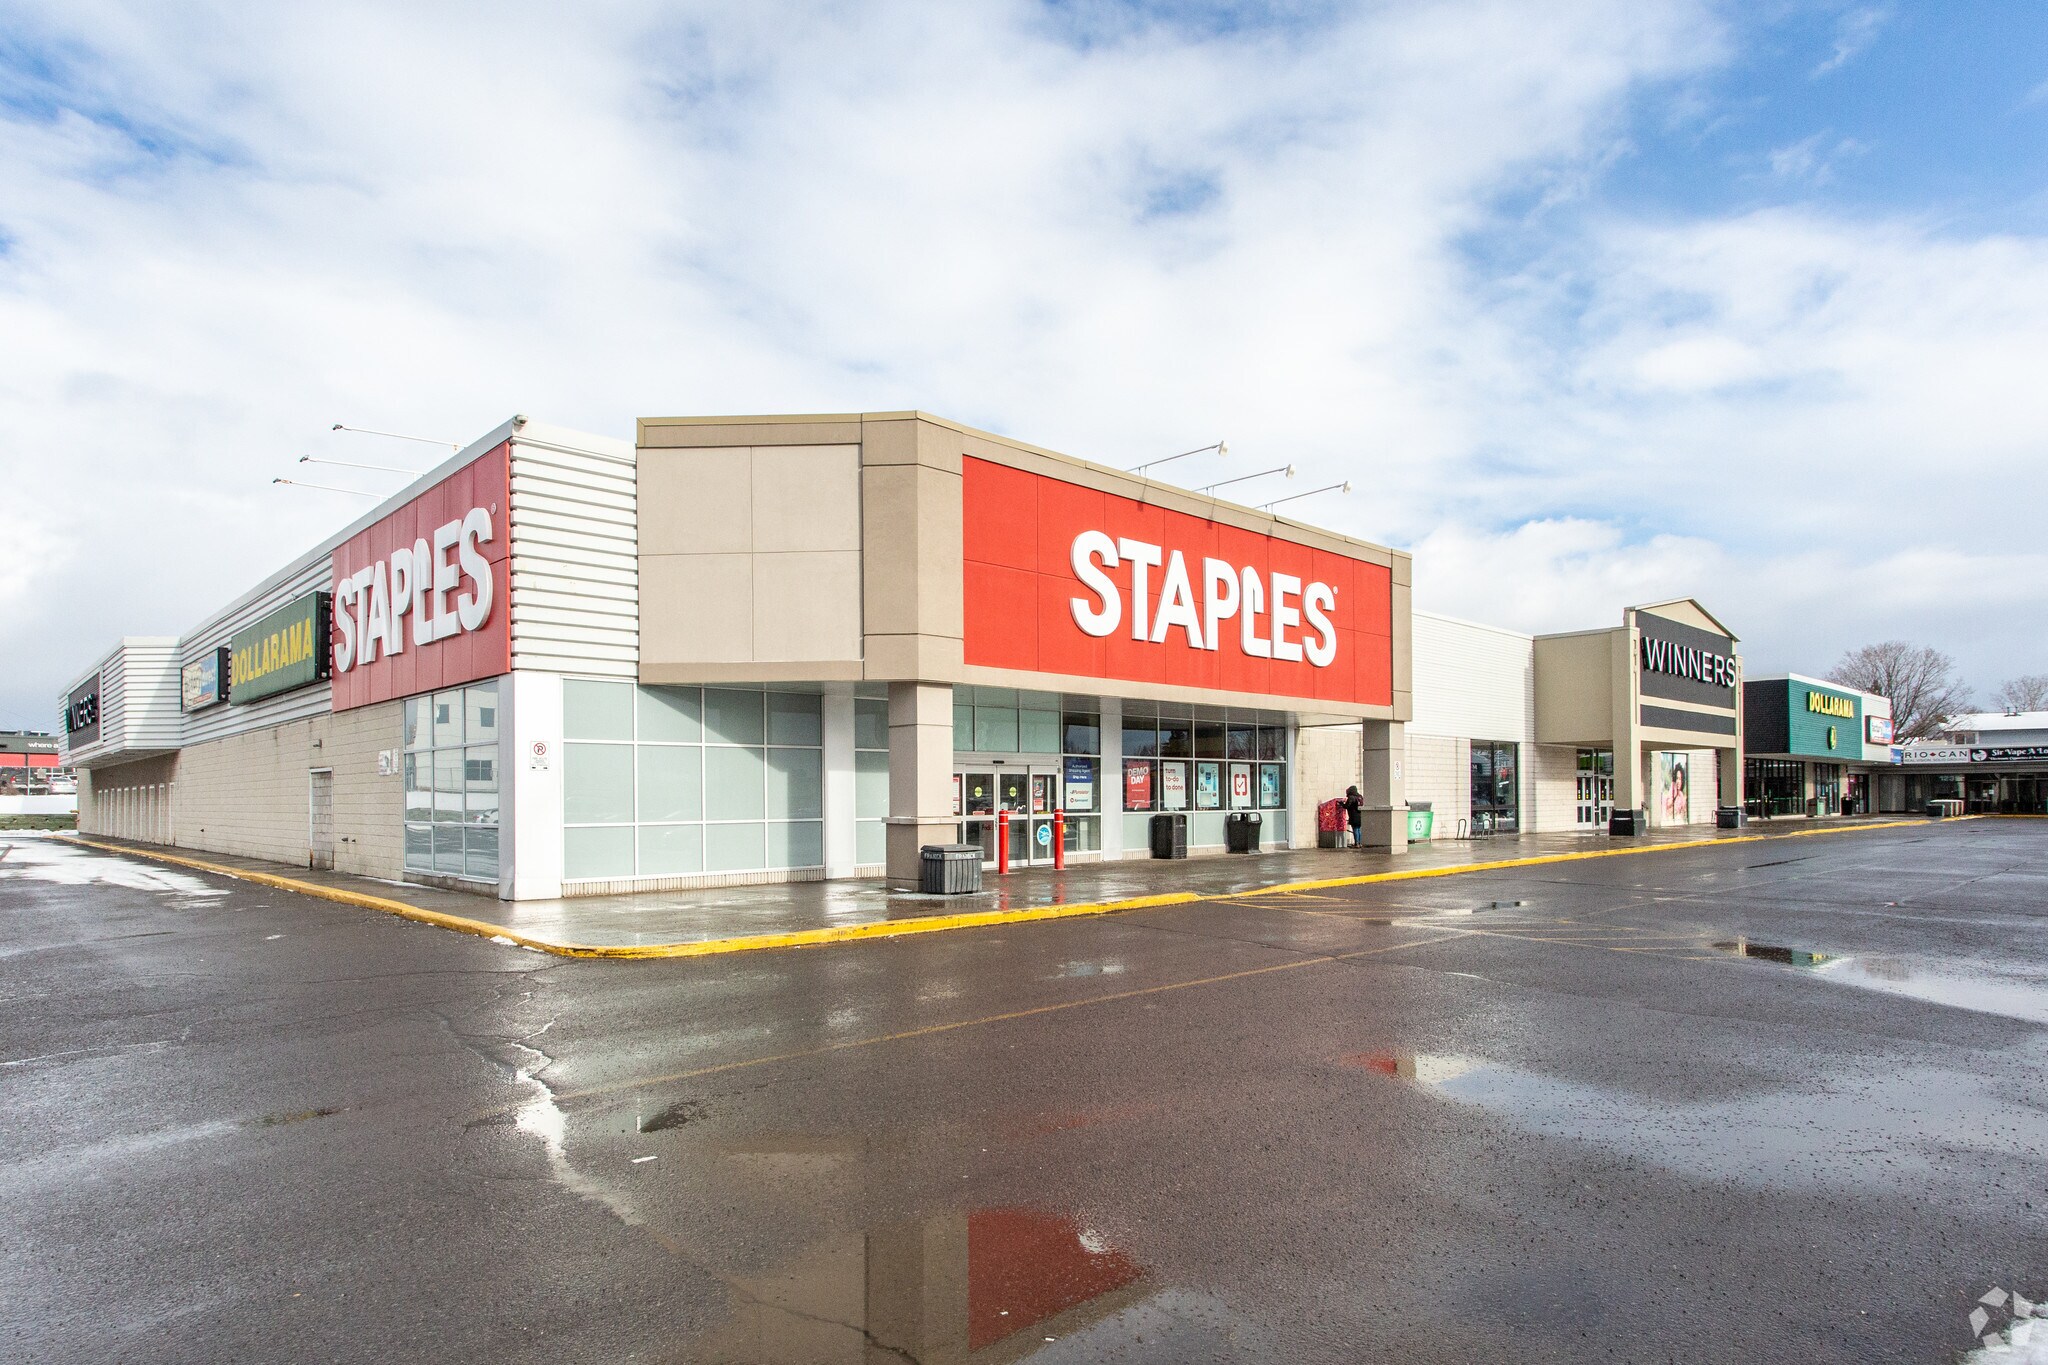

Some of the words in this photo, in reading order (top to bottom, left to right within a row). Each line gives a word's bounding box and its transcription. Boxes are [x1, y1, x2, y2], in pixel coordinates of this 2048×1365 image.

[335, 507, 494, 673] STAPLES
[1070, 530, 1337, 668] STAPLES
[231, 617, 313, 688] DOLLARAMA
[1643, 636, 1736, 688] WINNERS
[1809, 691, 1854, 719] DOLLARAMA
[1938, 750, 1967, 758] CAN
[1991, 749, 2004, 757] Sir
[2005, 748, 2027, 756] Vape
[1128, 766, 1149, 776] DEMO
[1131, 775, 1145, 784] DAY
